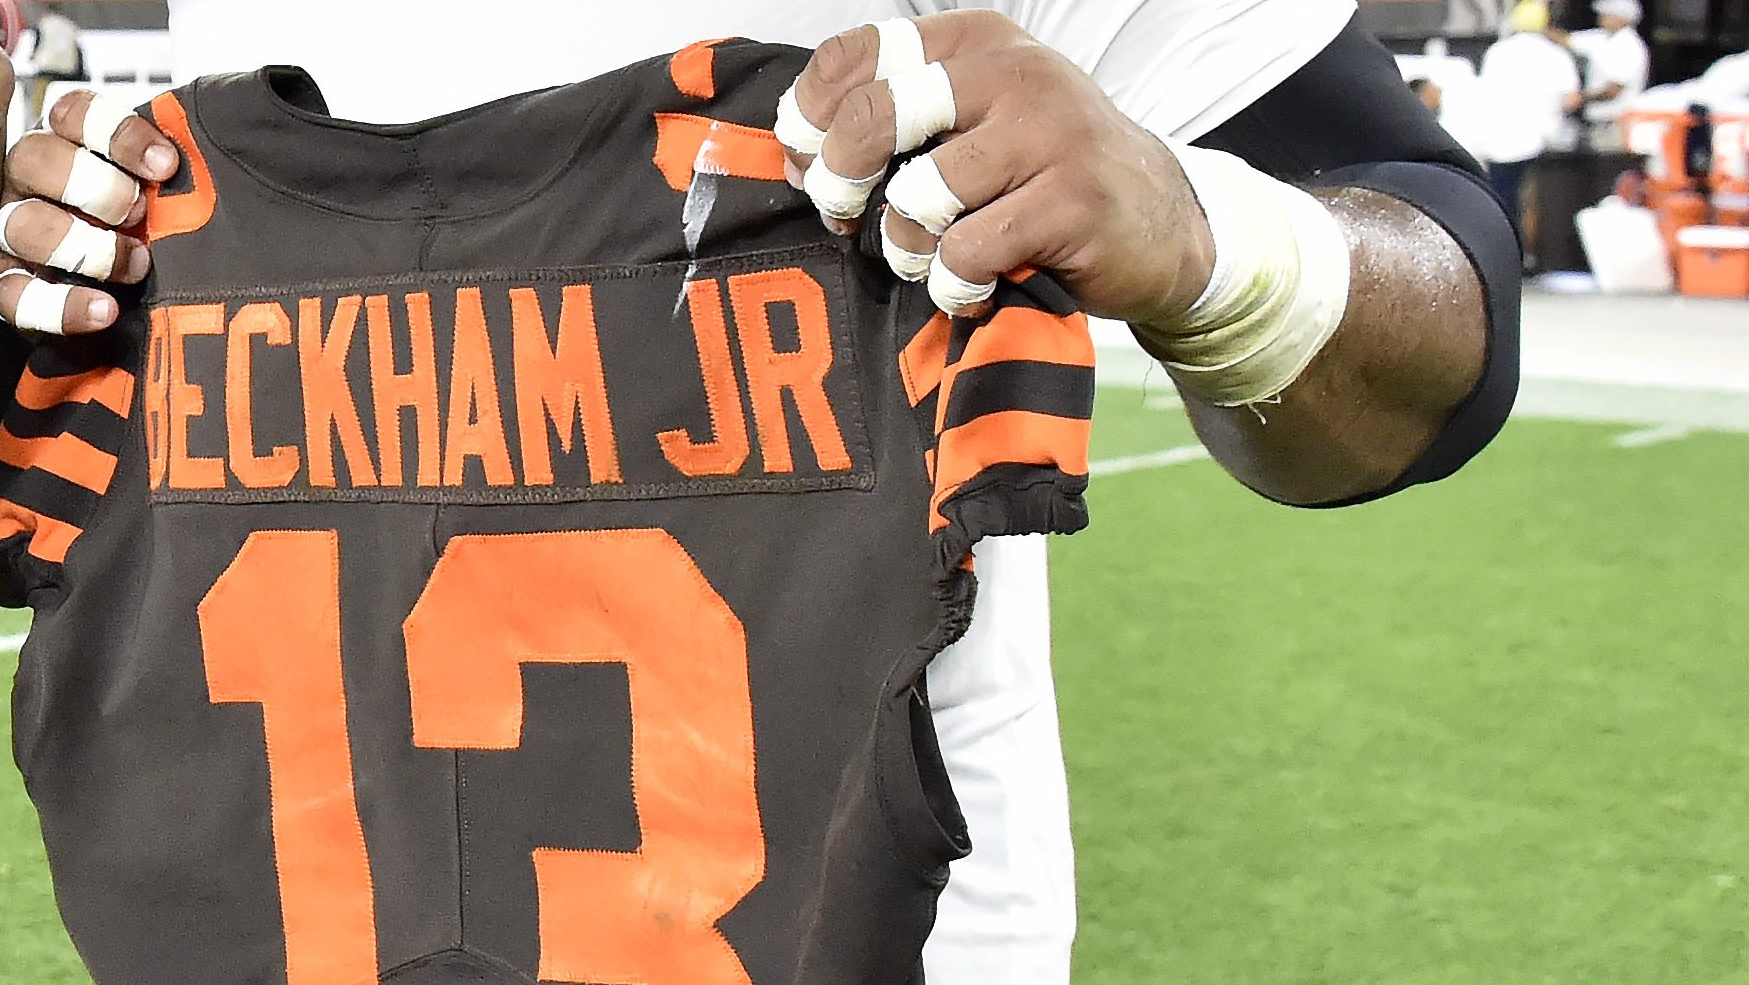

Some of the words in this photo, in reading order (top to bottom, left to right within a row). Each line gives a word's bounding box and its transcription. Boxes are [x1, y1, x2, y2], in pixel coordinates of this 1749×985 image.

[146, 285, 622, 490] BECKHAM
[657, 268, 852, 478] JR
[197, 528, 767, 985] 13
